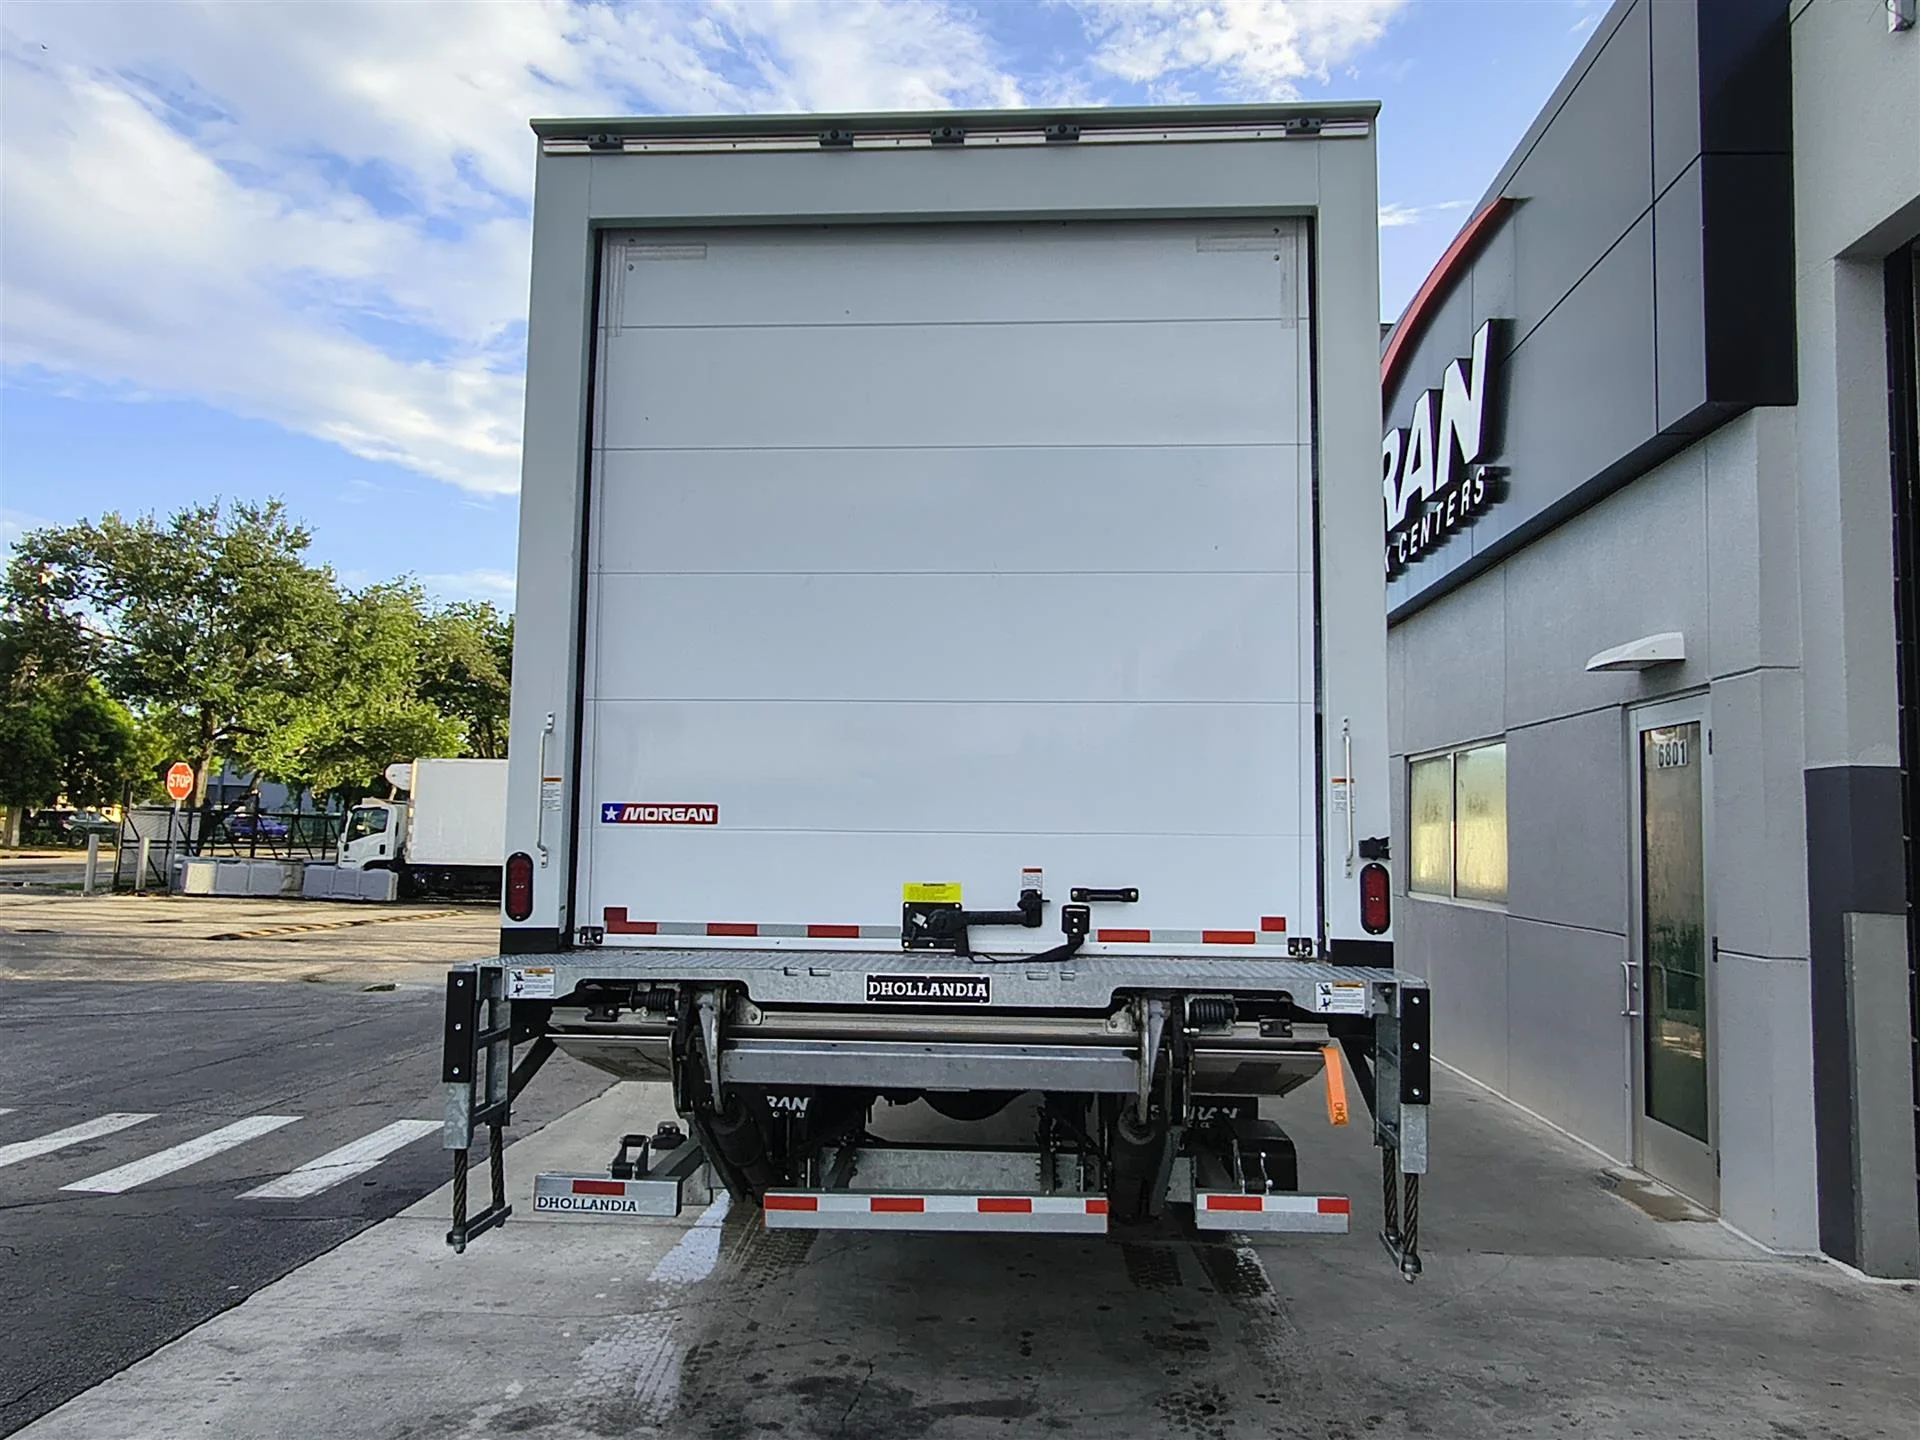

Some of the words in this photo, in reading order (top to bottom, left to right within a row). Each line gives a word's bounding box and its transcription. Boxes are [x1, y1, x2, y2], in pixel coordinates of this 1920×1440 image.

[1398, 465, 1486, 564] CENTERS
[1658, 740, 1686, 767] 6801
[170, 773, 192, 788] STOP
[622, 806, 714, 822] MORGAN
[868, 981, 988, 998] DHOLLANDIA
[537, 1195, 637, 1213] DHOLLANDIA
